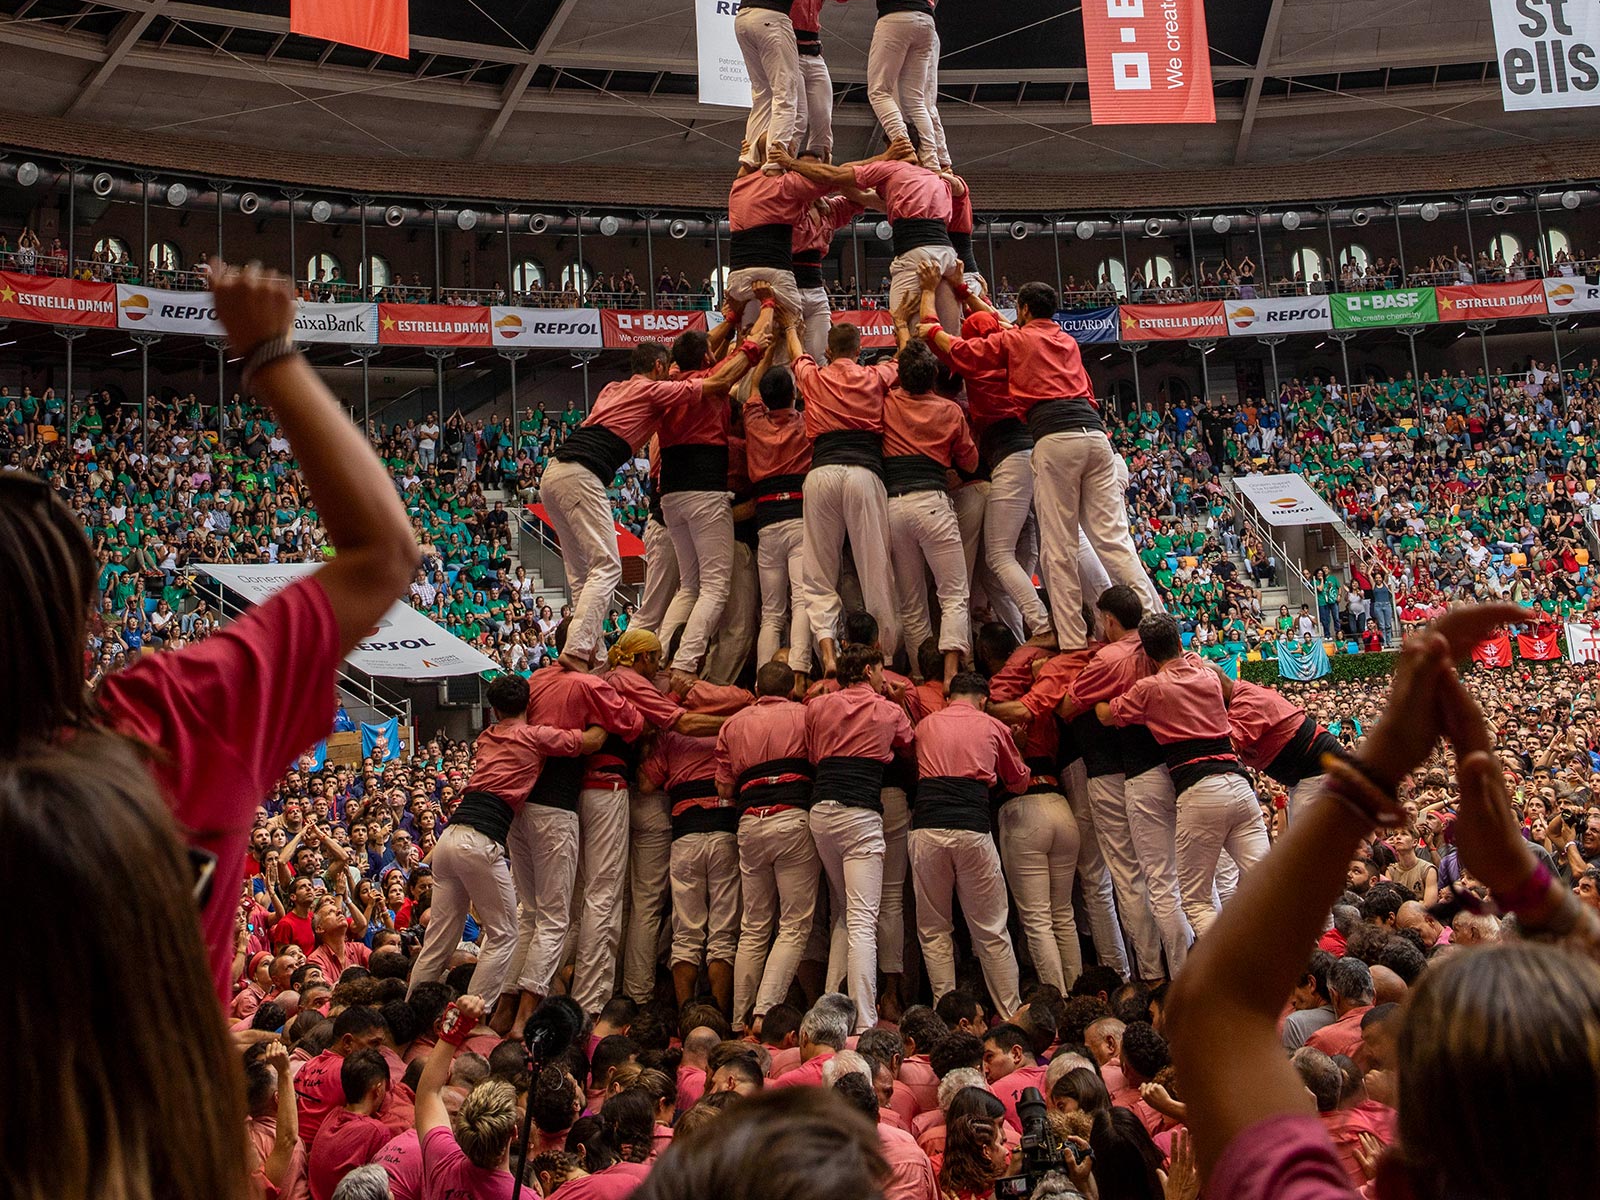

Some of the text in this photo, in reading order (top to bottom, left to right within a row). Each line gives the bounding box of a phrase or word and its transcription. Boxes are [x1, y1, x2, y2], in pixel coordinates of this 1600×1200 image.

[1165, 57, 1184, 90] We
[18, 292, 114, 313] ESTRELLA DAMM
[1371, 292, 1419, 309] BASF
[1455, 293, 1543, 309] ESTRELLA DAMM
[161, 304, 218, 321] REPSO
[1266, 308, 1329, 322] REPSOL
[1362, 314, 1385, 322] create
[1386, 311, 1421, 321] chemistry
[294, 314, 366, 332] aixaBank
[398, 320, 489, 333] ESTRELLA DAMM
[533, 322, 599, 335] REPSOL
[643, 314, 689, 330] BASF
[1139, 315, 1224, 329] ESTRELLA DAMM
[619, 334, 632, 342] We
[633, 335, 656, 343] create
[1272, 507, 1316, 515] REPSOL
[237, 575, 290, 583] Donem
[355, 637, 436, 652] EPSOL
